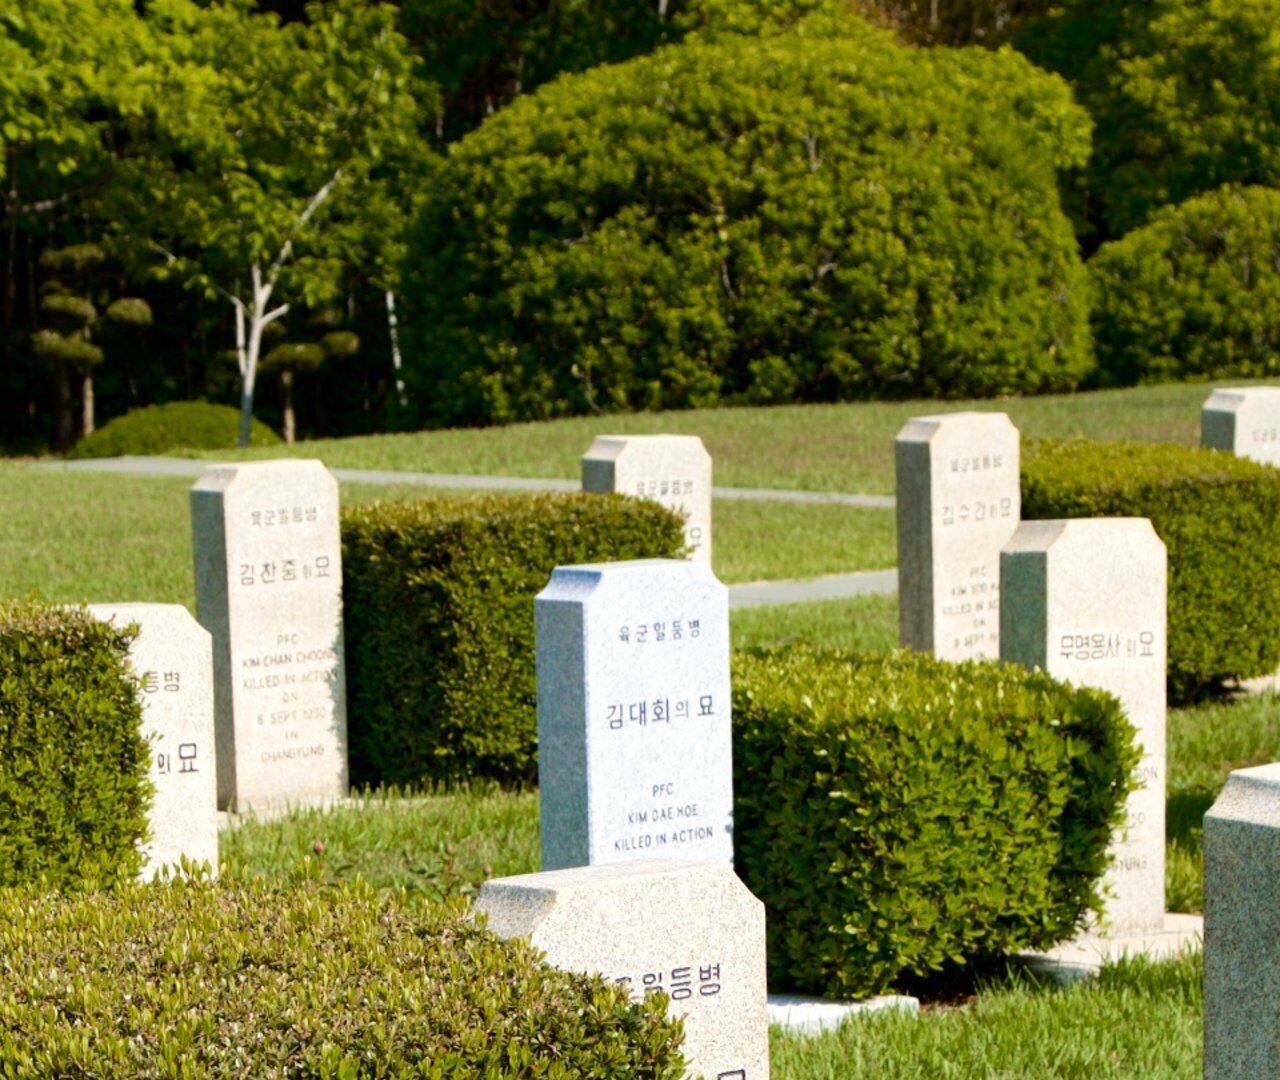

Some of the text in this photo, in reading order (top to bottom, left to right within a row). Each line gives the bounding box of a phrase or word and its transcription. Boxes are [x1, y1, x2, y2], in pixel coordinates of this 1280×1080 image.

[620, 619, 700, 643] 육군일등병
[652, 782, 674, 798] PFC
[628, 810, 648, 824] KIM
[614, 826, 713, 852] KILLED IN ACTION
